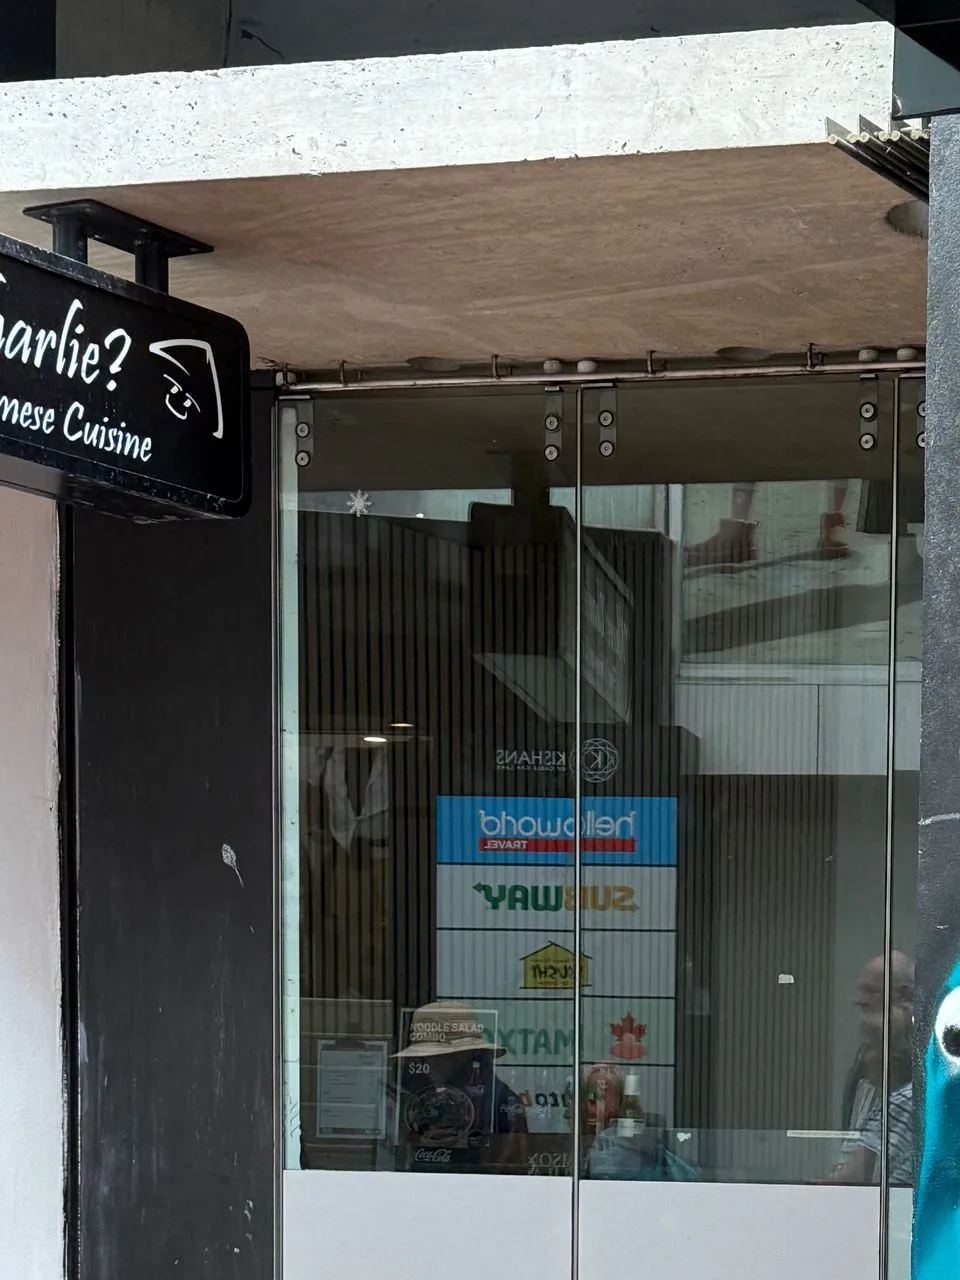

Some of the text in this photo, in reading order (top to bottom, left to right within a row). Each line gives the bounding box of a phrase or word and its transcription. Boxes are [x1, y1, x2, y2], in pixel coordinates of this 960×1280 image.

[0, 272, 132, 392] arlie?
[63, 401, 152, 462] Cuisine
[409, 1022, 485, 1033] NOODLE SALAD
[409, 1032, 446, 1042] COMBO
[408, 1061, 431, 1075] $20
